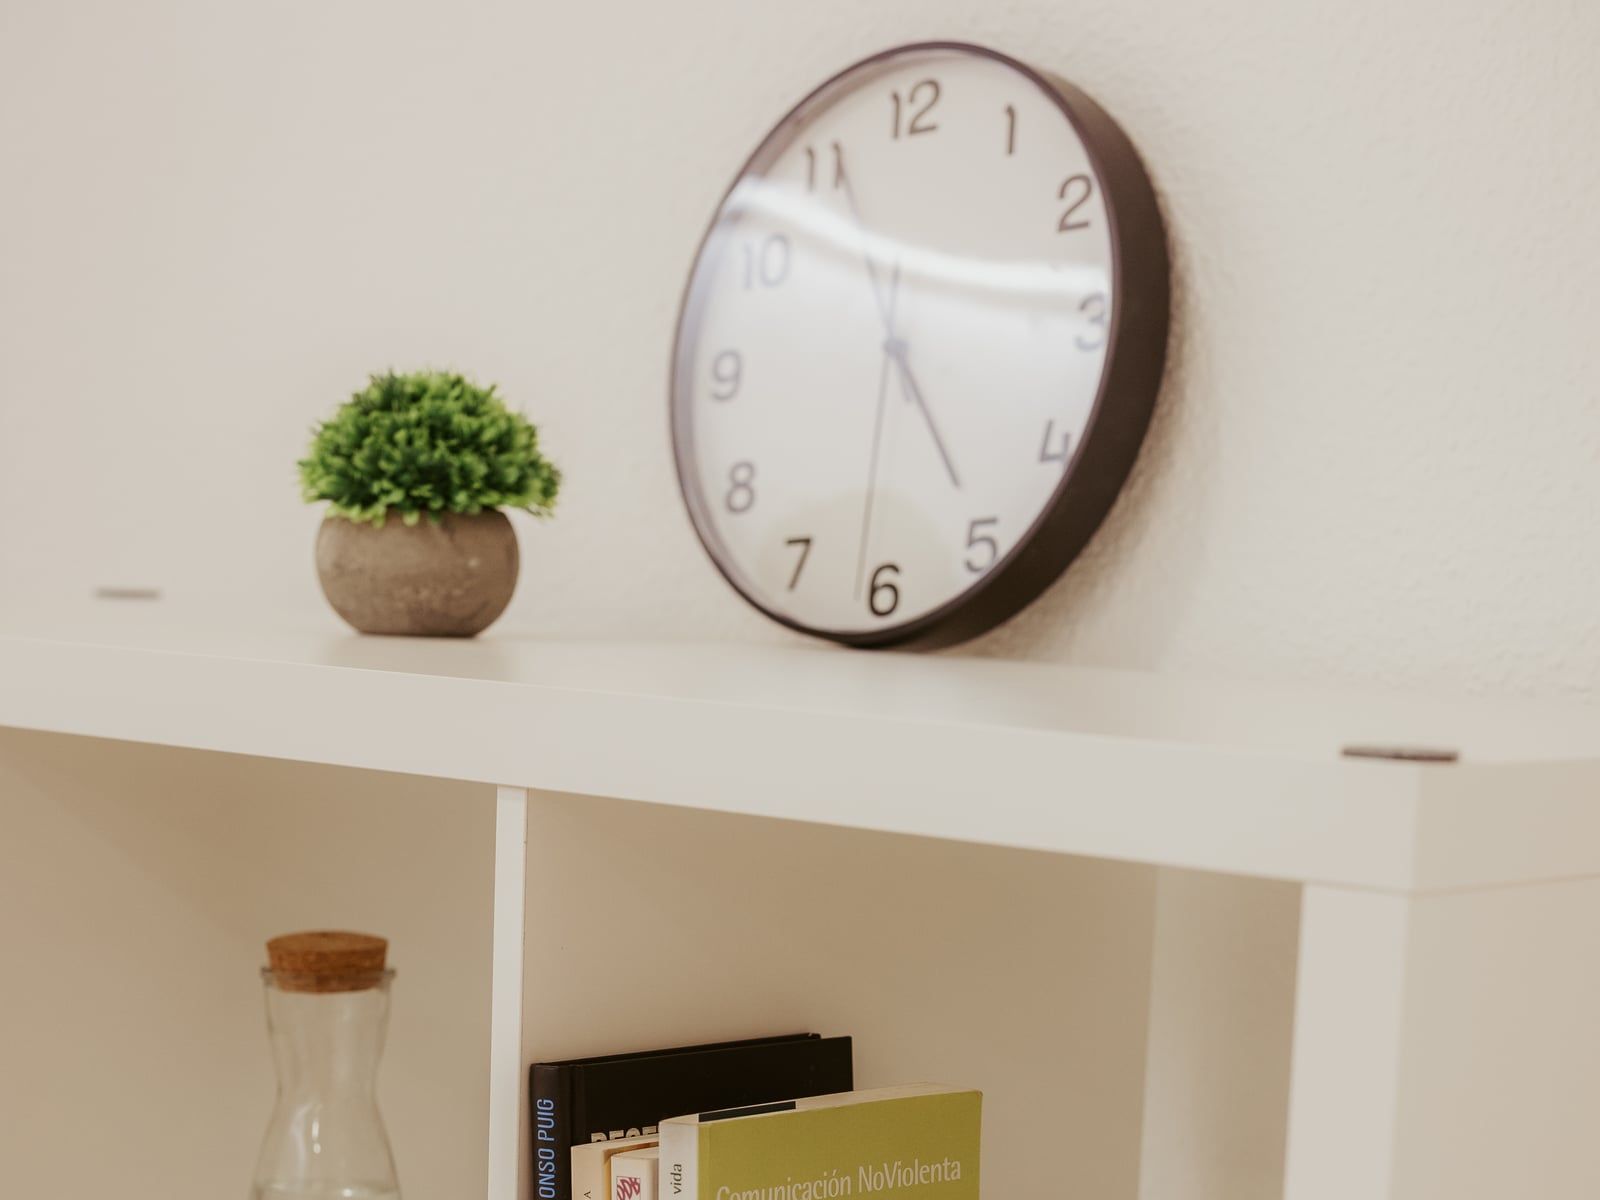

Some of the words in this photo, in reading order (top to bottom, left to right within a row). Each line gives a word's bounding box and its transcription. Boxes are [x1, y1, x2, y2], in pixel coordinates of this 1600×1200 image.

[891, 79, 941, 140] 12
[1004, 104, 1018, 156] 1
[805, 141, 845, 191] 11
[1057, 174, 1094, 233] 2
[741, 234, 790, 292] 10
[1073, 290, 1107, 352] 3
[711, 350, 743, 402] 9
[1038, 420, 1073, 465] 4
[726, 462, 756, 513] 8
[785, 538, 813, 592] 7
[963, 518, 999, 573] 5
[869, 564, 902, 617] 6
[537, 1099, 555, 1141] PUIG
[669, 1163, 682, 1194] vida
[858, 1157, 961, 1193] NoViolenta
